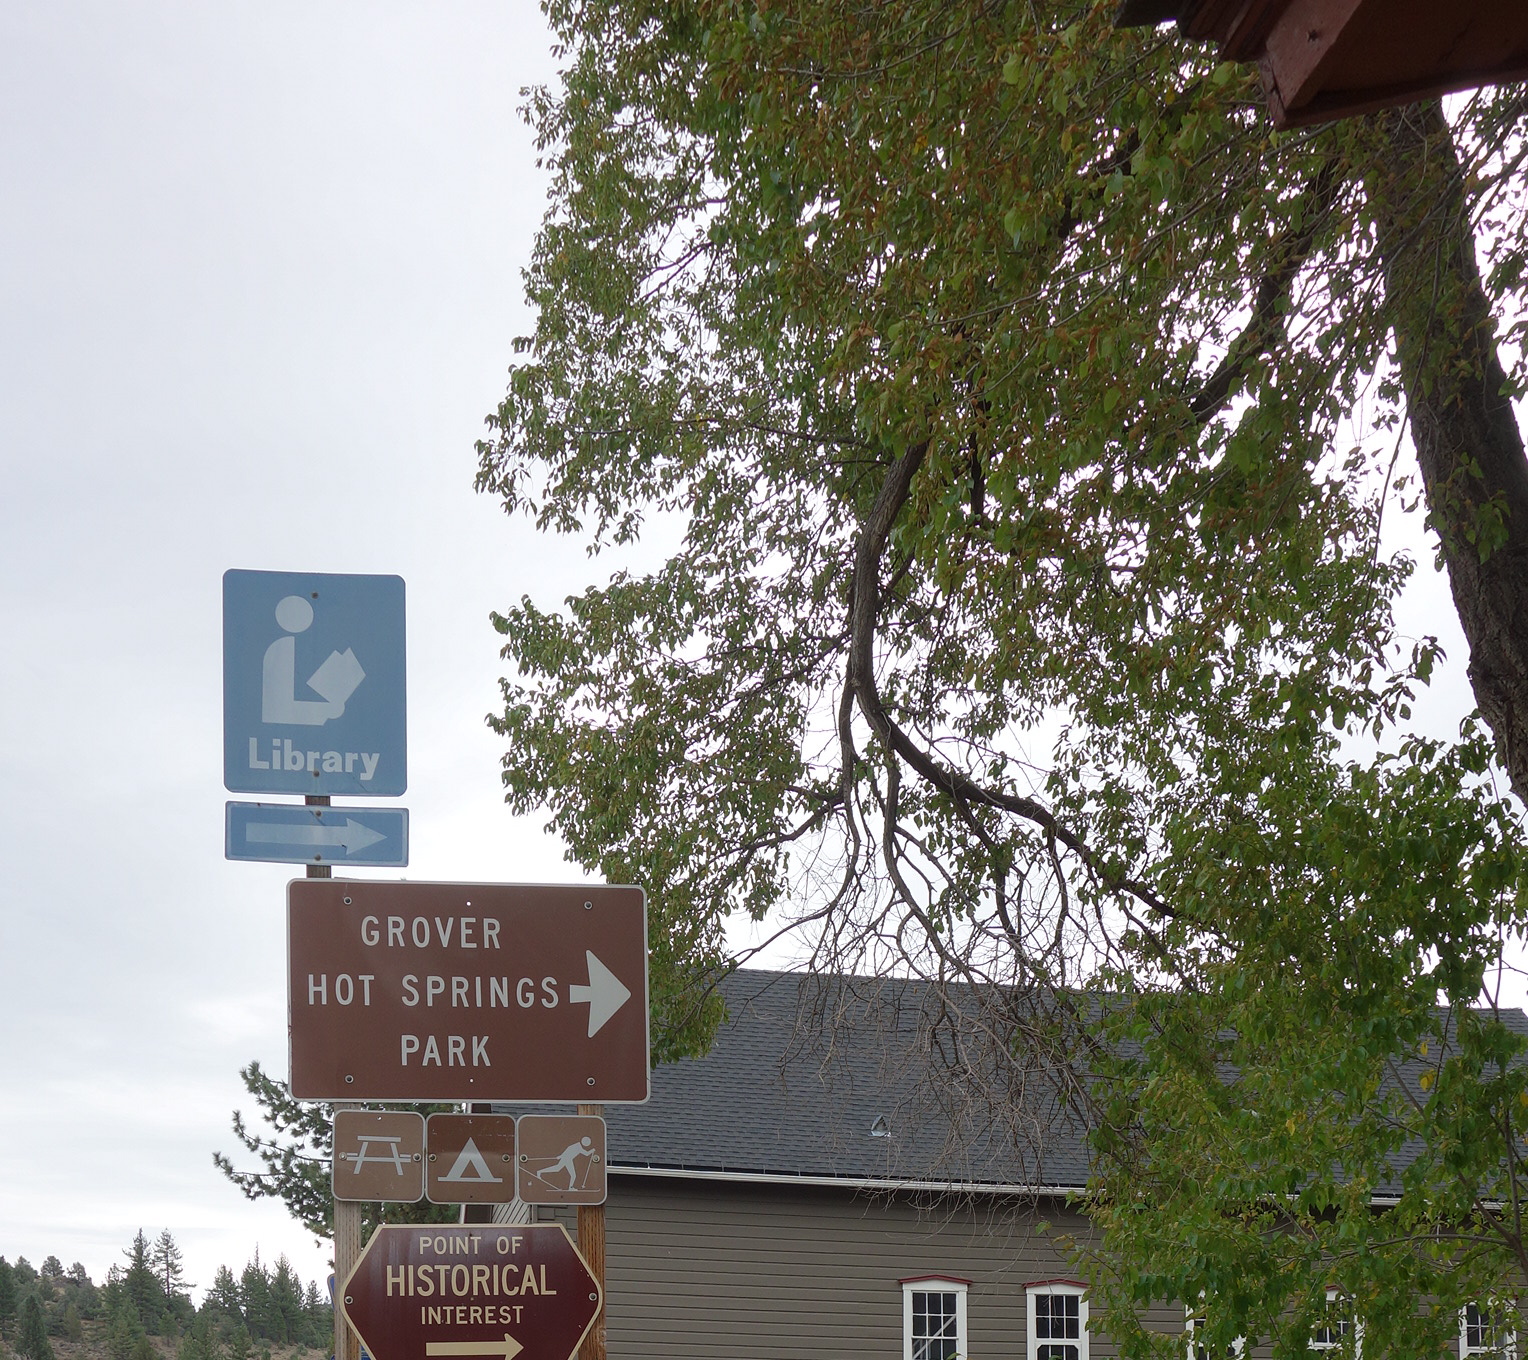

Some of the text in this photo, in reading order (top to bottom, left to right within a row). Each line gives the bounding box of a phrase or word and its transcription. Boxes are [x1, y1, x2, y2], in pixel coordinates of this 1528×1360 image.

[248, 736, 381, 782] Library
[361, 916, 501, 949] GROVER
[307, 973, 560, 1009] HOT SPRINGS
[401, 1034, 492, 1067] PARK
[419, 1236, 524, 1255] POINT OF
[386, 1264, 557, 1297] HISTORICAL
[421, 1305, 524, 1325] INTEREST
